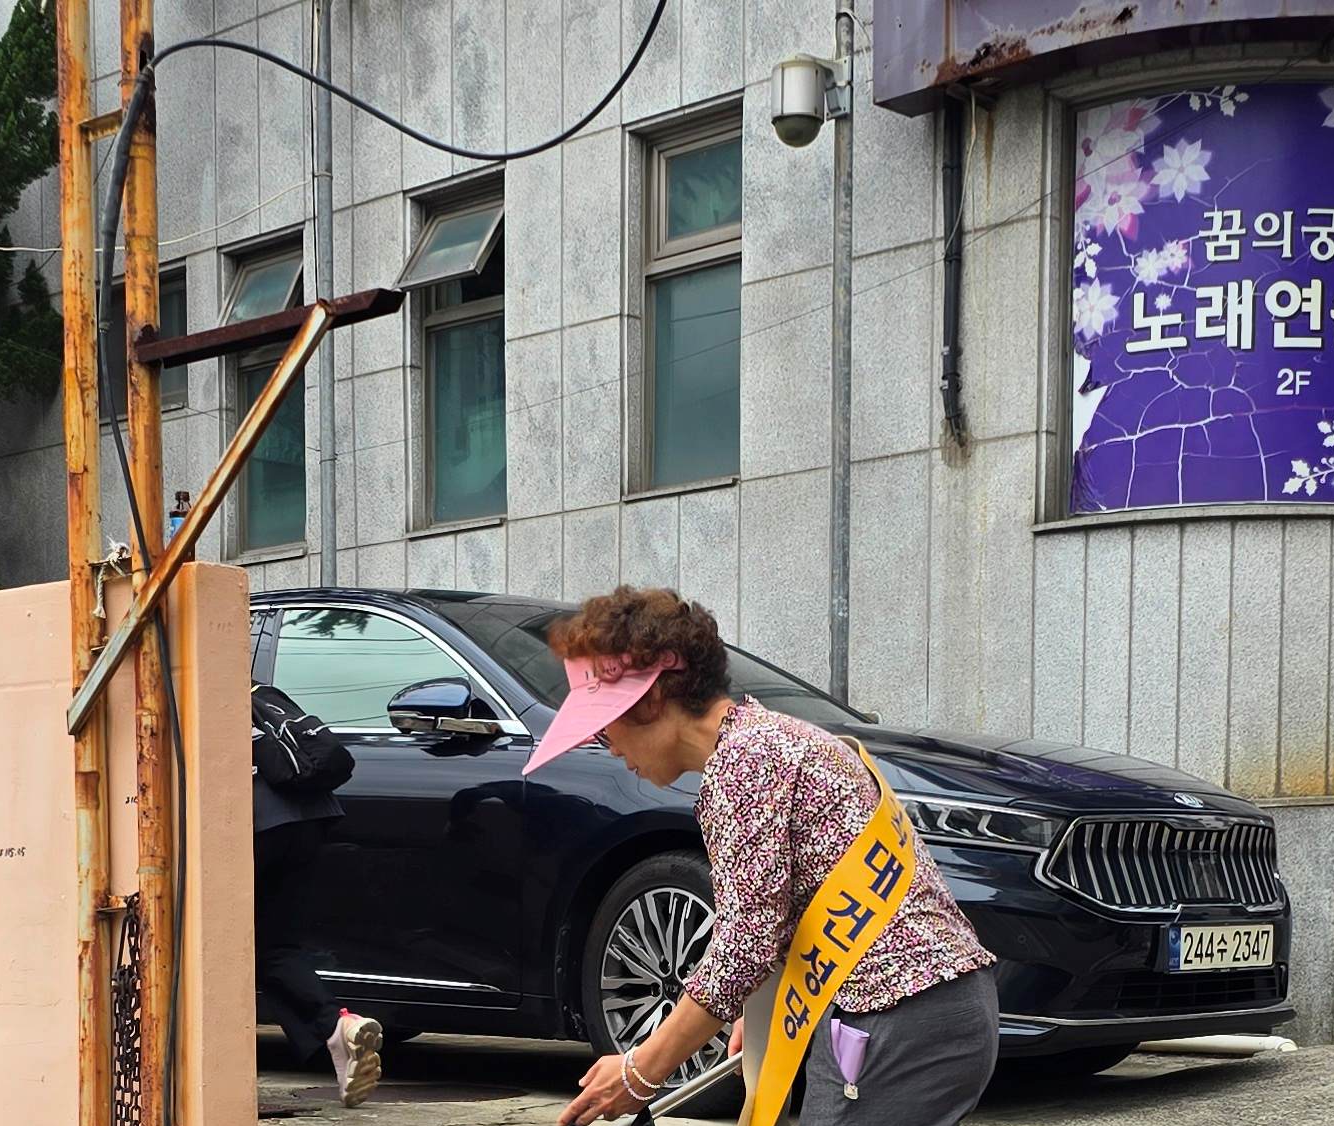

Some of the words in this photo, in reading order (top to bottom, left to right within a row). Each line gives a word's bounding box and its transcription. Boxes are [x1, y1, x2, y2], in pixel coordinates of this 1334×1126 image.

[1275, 368, 1312, 396] 2F
[781, 838, 906, 1041] 대건성당
[1183, 931, 1228, 965] 244수
[1232, 930, 1271, 963] 2347
